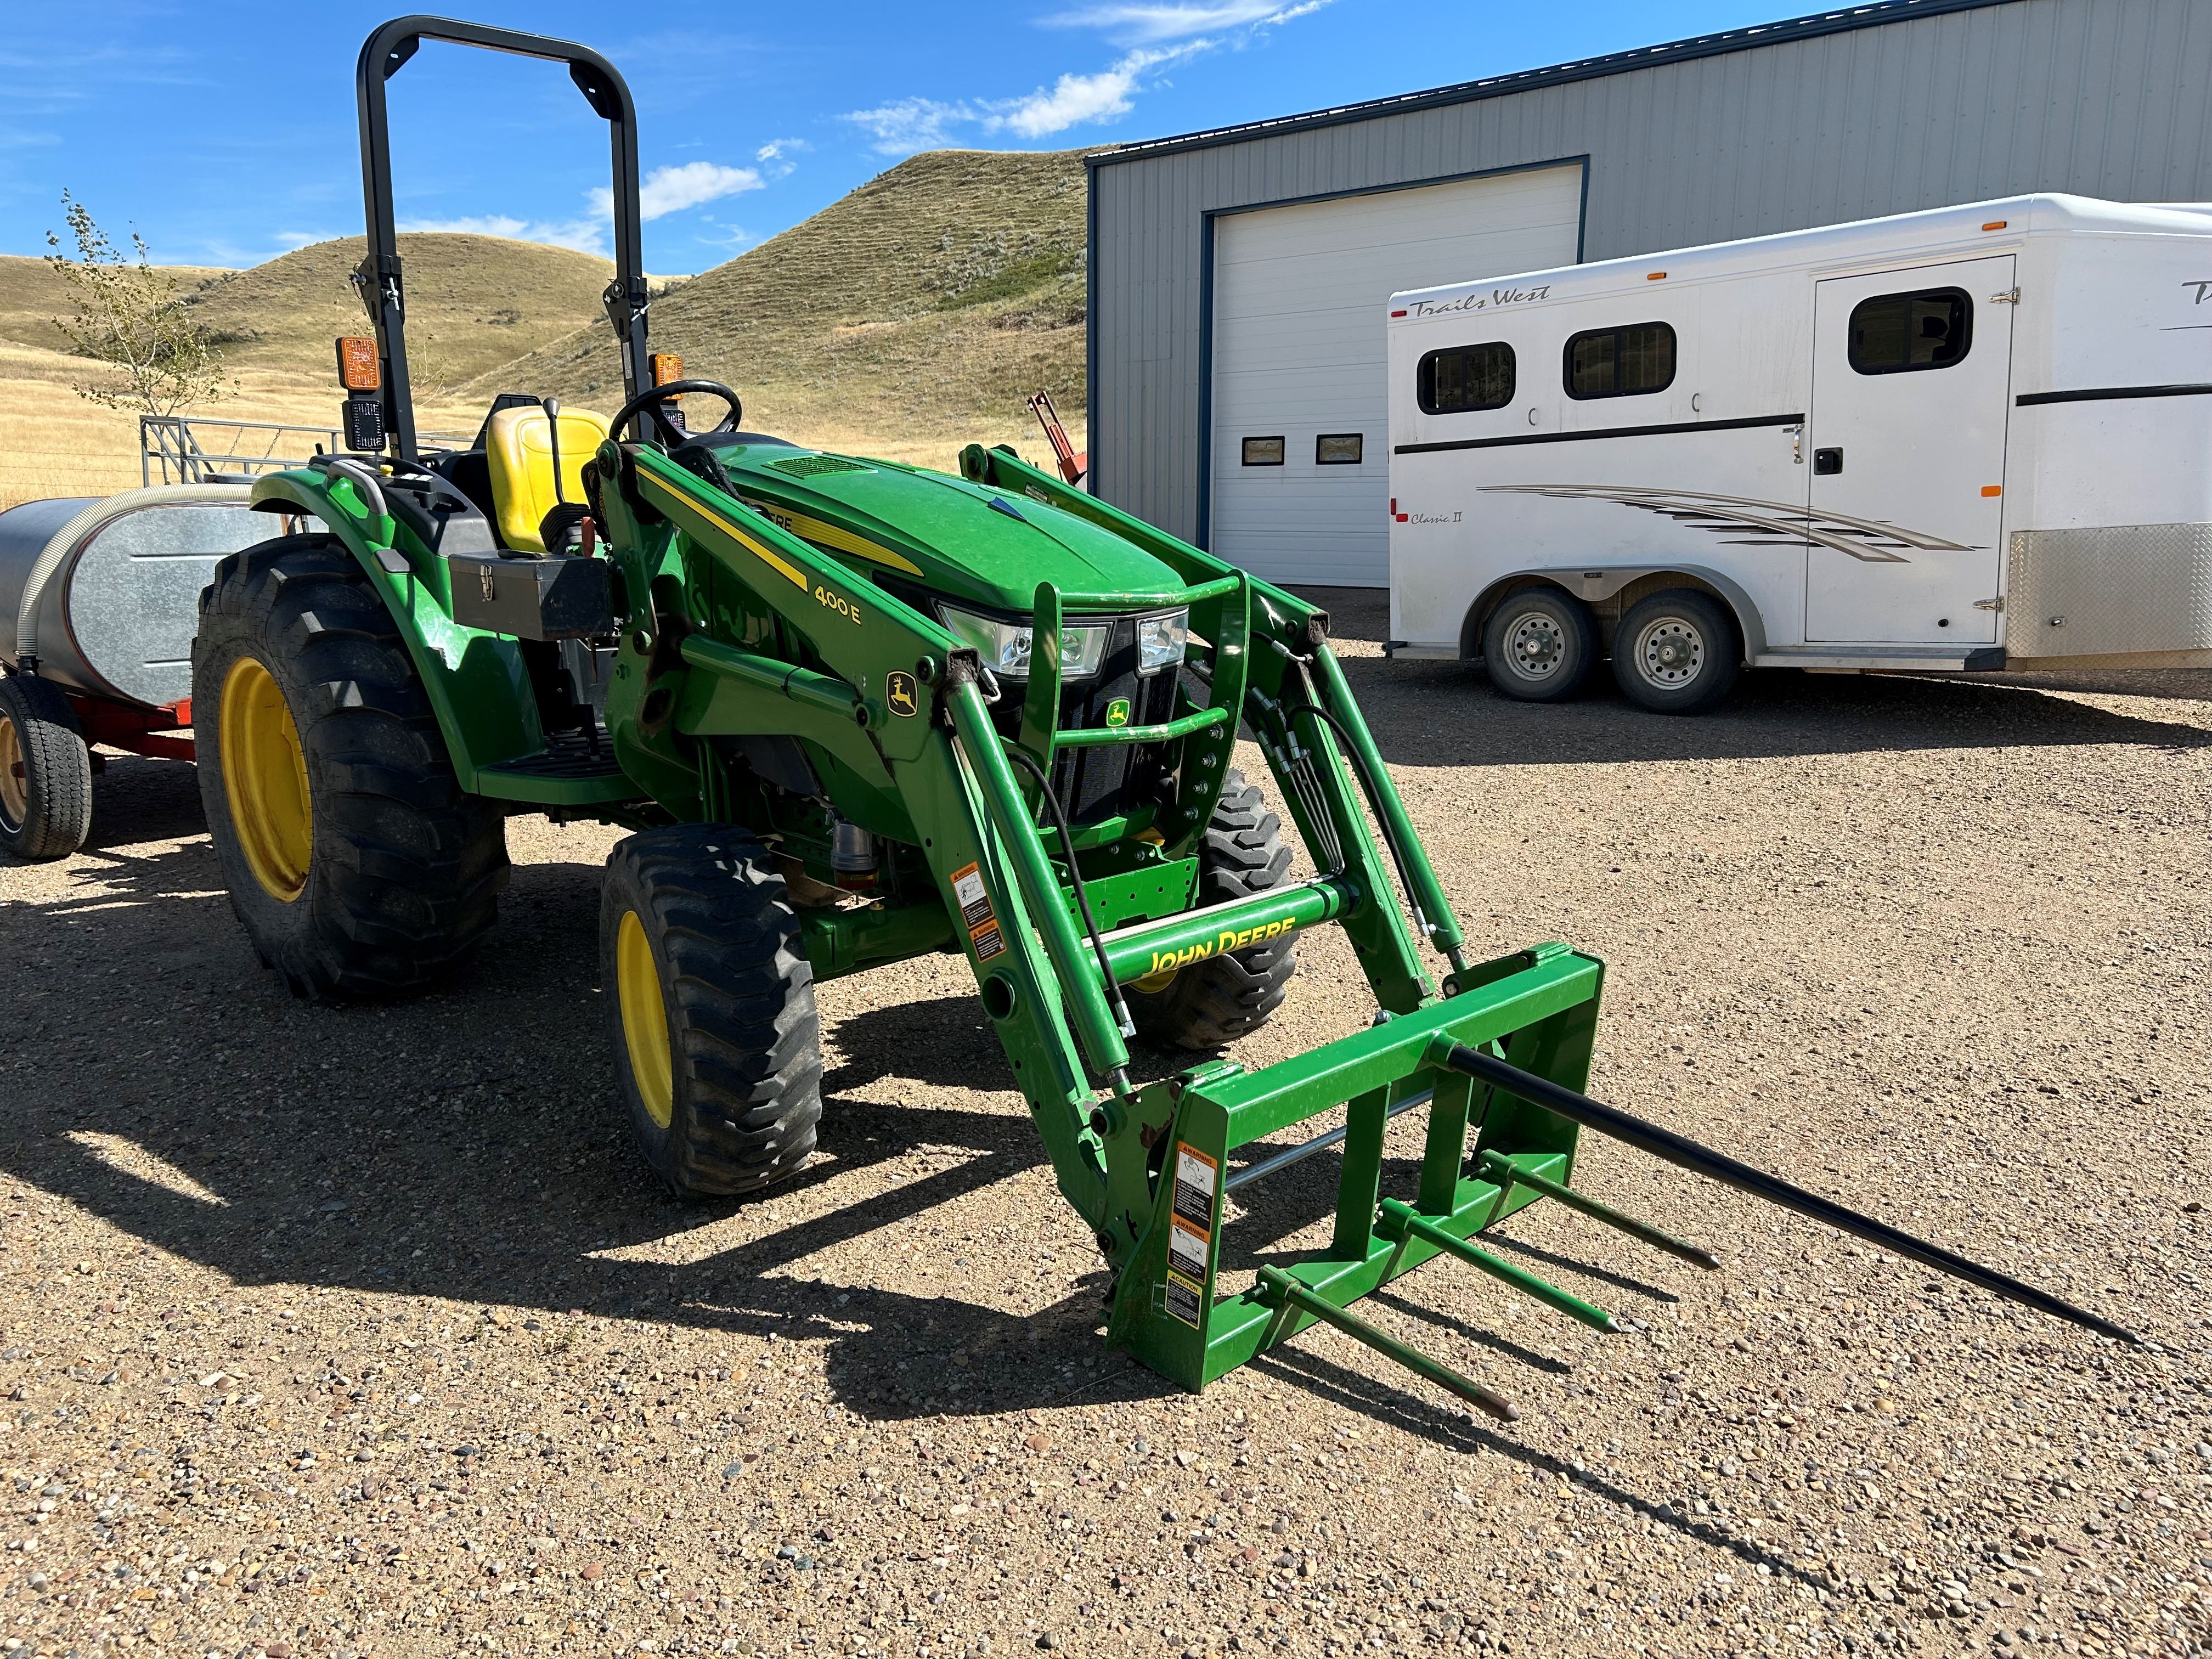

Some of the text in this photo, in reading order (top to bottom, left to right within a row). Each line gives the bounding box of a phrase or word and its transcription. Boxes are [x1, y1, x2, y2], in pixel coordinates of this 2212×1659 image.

[2181, 280, 2212, 304] T
[1409, 285, 1550, 317] Trails West
[1411, 511, 1463, 524] Classic II
[815, 585, 862, 625] 400 E
[957, 865, 975, 878] WARNING
[978, 923, 996, 935] WARNING
[1141, 917, 1296, 978] JOHN DEERE
[1187, 1147, 1212, 1165] WARNING
[1181, 1222, 1205, 1239] WARNING
[1175, 1276, 1198, 1293] CAUTION
